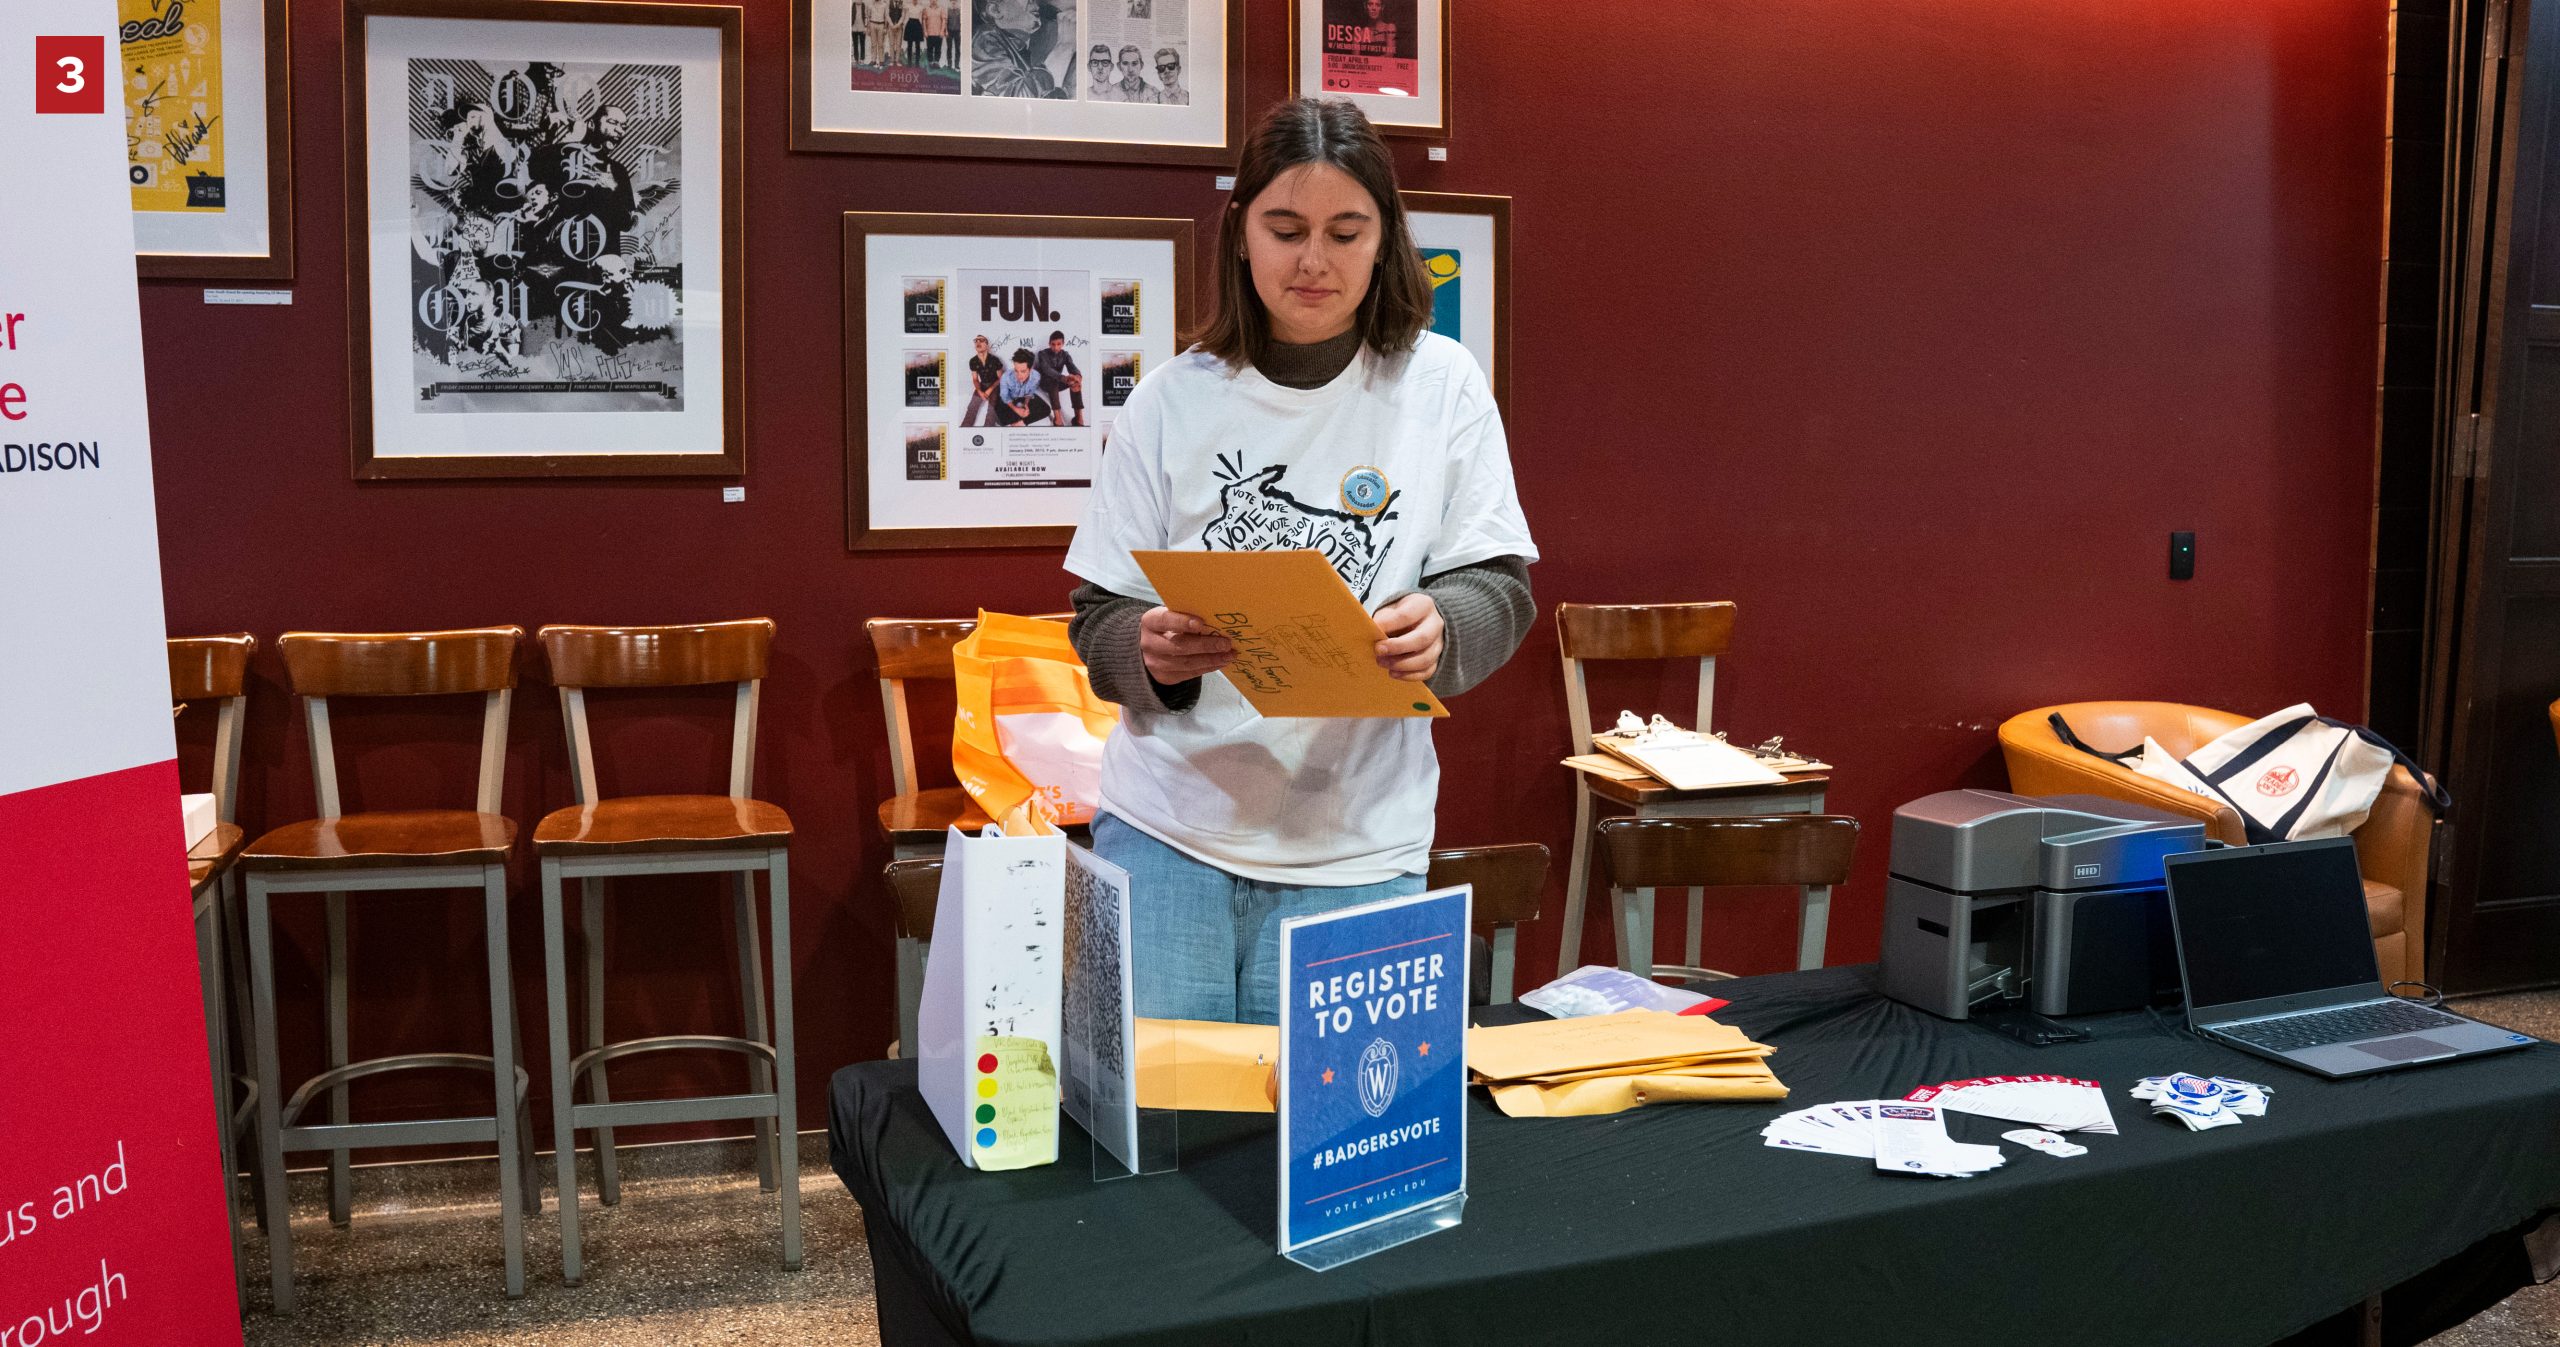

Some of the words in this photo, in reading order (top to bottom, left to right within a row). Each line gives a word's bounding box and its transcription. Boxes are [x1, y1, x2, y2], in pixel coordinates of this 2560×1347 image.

[1328, 24, 1371, 43] DESSA
[890, 73, 920, 83] PHOX
[918, 305, 937, 314] FUN.
[981, 285, 1061, 322] FUN.
[1114, 306, 1133, 316] FUN.
[0, 312, 24, 350] r
[919, 378, 939, 387] FUN.
[1115, 378, 1134, 387] FUN.
[0, 383, 27, 420] e
[920, 451, 939, 460] FUN.
[1232, 487, 1257, 505] VOTE
[1261, 500, 1289, 513] VOTE
[1211, 506, 1238, 534] VOTE
[1217, 508, 1269, 551] VOTE
[1264, 517, 1291, 533] VOTE
[1320, 520, 1336, 528] VOTE
[1341, 526, 1361, 552] VOTE
[1306, 522, 1360, 584] VOTE
[2077, 866, 2098, 876] HID
[1309, 953, 1445, 1009] REGISTER
[1315, 1005, 1353, 1038] TO
[1365, 984, 1438, 1026] VOTE
[1368, 1061, 1390, 1101] W
[1312, 1117, 1441, 1170] #BADGERSVOTE
[0, 1201, 37, 1248] us
[52, 1139, 128, 1220] and
[1325, 1178, 1427, 1217] VOTE.WISC.EDU
[0, 1258, 128, 1347] rough
